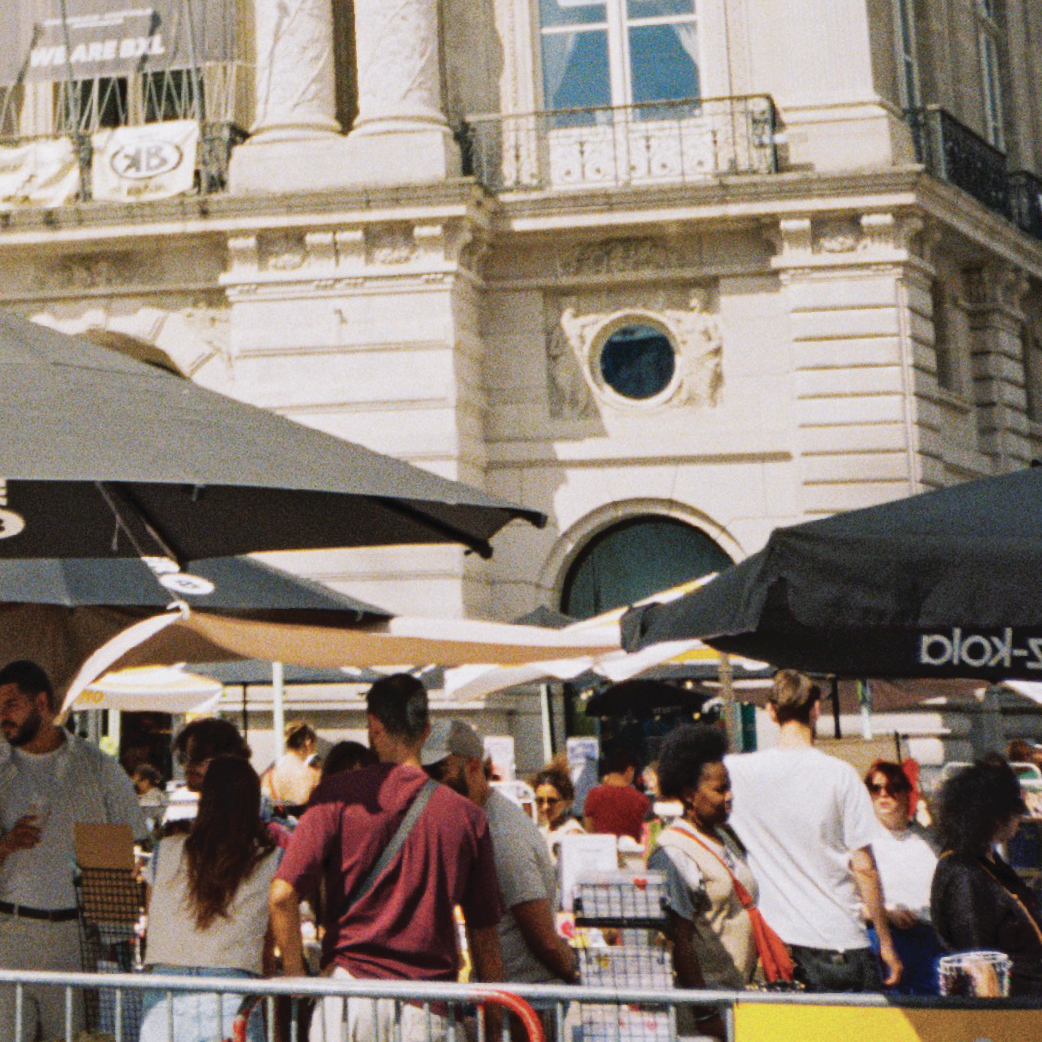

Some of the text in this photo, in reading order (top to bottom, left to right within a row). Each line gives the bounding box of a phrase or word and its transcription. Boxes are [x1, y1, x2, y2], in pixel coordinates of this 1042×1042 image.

[31, 34, 165, 68] WE ARE BXL
